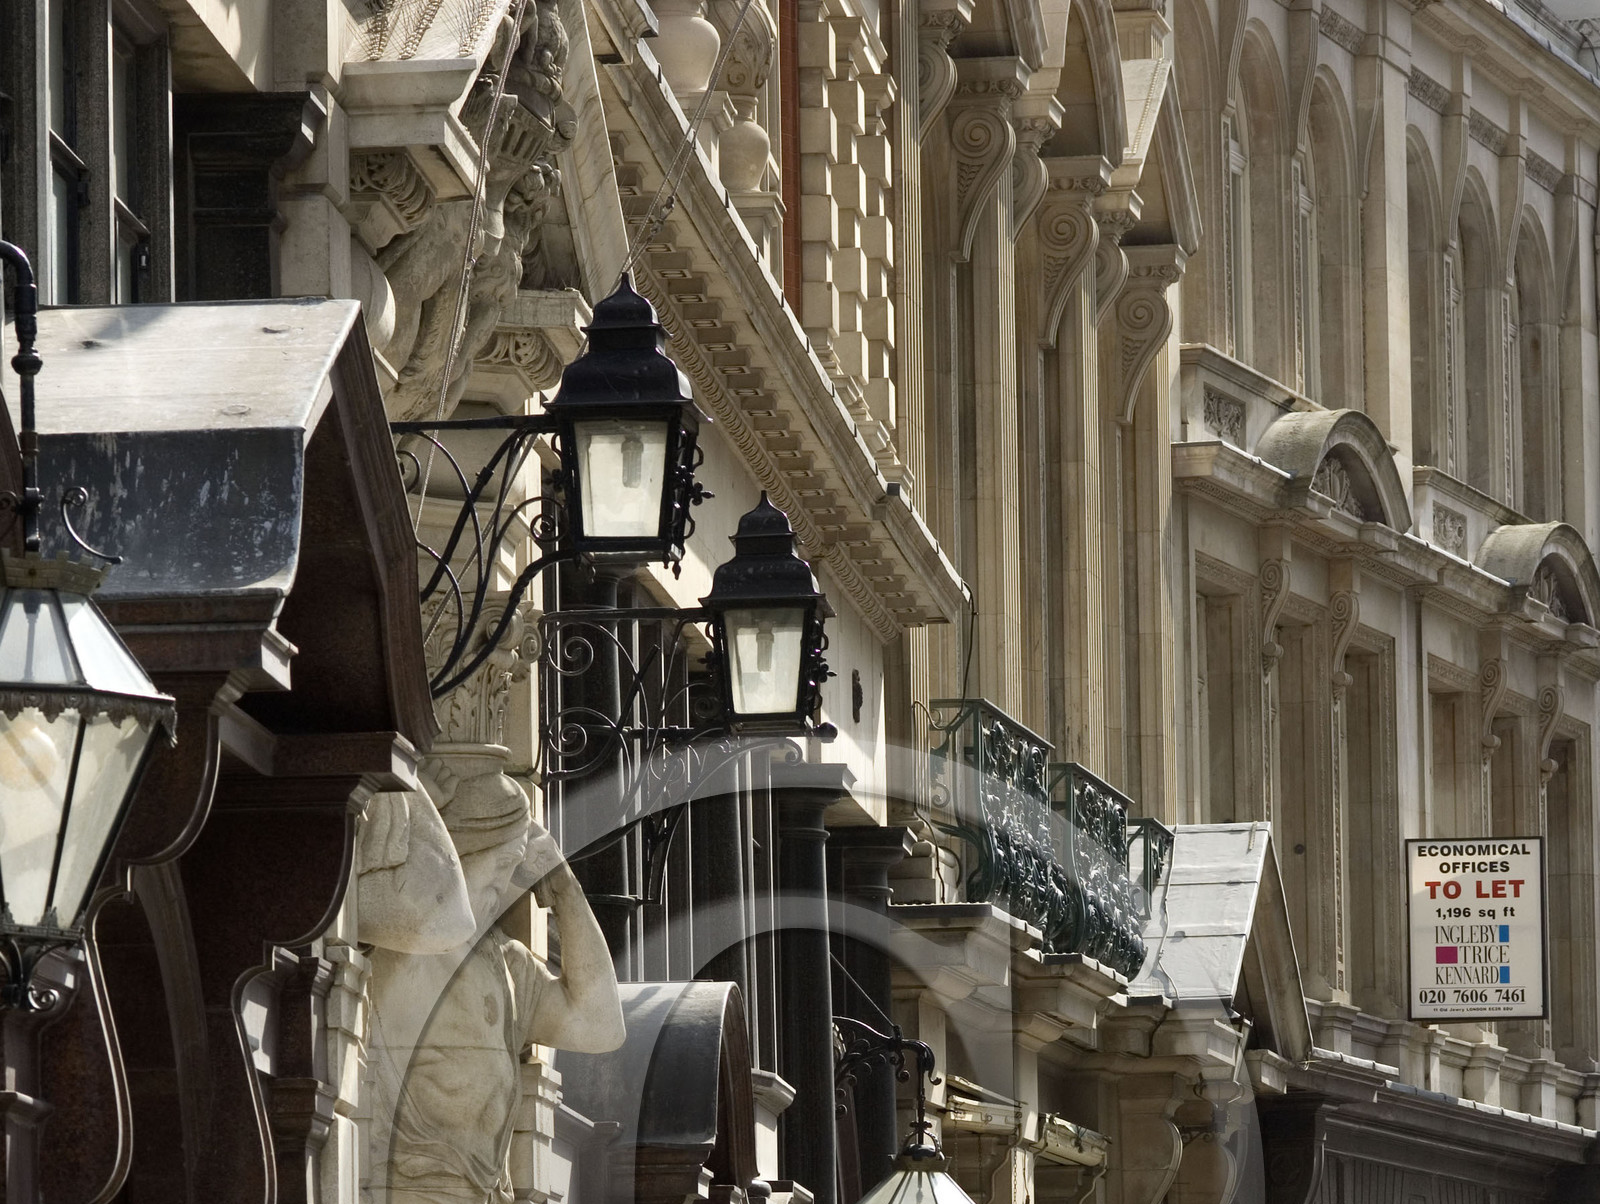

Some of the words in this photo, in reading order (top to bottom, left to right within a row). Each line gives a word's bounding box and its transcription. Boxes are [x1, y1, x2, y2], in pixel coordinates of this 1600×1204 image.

[1417, 843, 1531, 857] ECONOMICAL
[1439, 861, 1510, 873] OFFICES
[1424, 880, 1462, 899] TO
[1475, 879, 1525, 898] LET
[1436, 907, 1471, 920] 1,196
[1478, 908, 1496, 920] sq
[1503, 906, 1515, 917] ft
[1435, 924, 1498, 944] INGLEBY
[1459, 945, 1510, 964] TRICE
[1435, 965, 1499, 984] KENNARD
[1419, 989, 1446, 1004] 020
[1453, 989, 1488, 1004] 7606
[1494, 988, 1526, 1003] 7461
